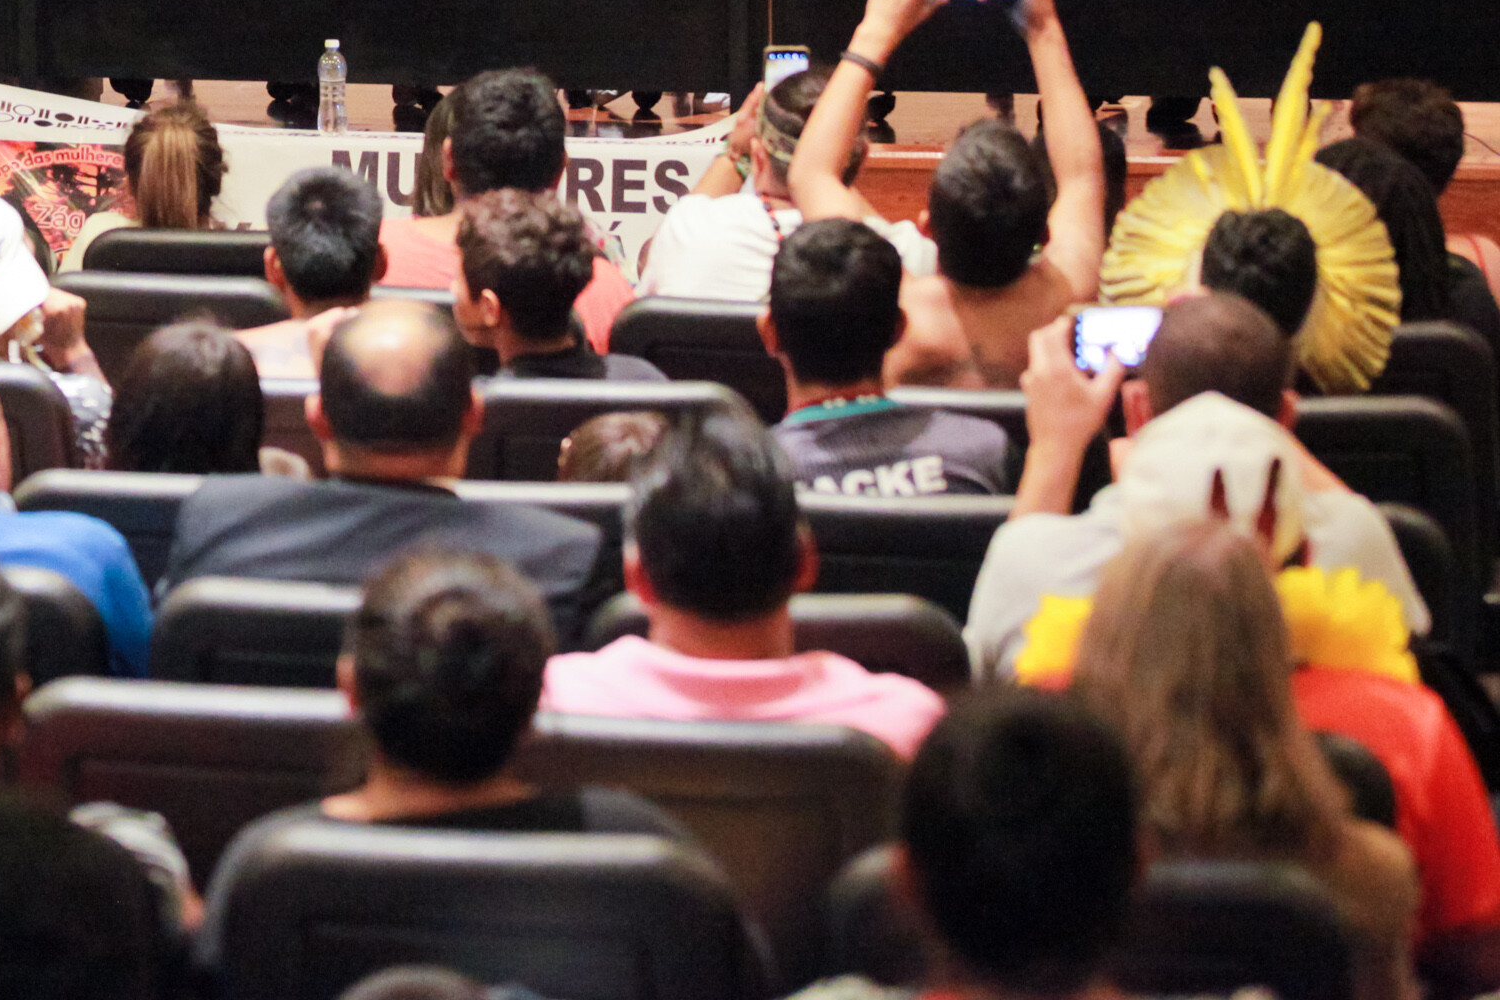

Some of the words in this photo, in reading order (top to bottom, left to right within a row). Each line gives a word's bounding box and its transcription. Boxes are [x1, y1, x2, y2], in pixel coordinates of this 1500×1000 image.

[23, 149, 51, 168] das
[55, 145, 123, 166] mulhere
[331, 150, 690, 215] MURES
